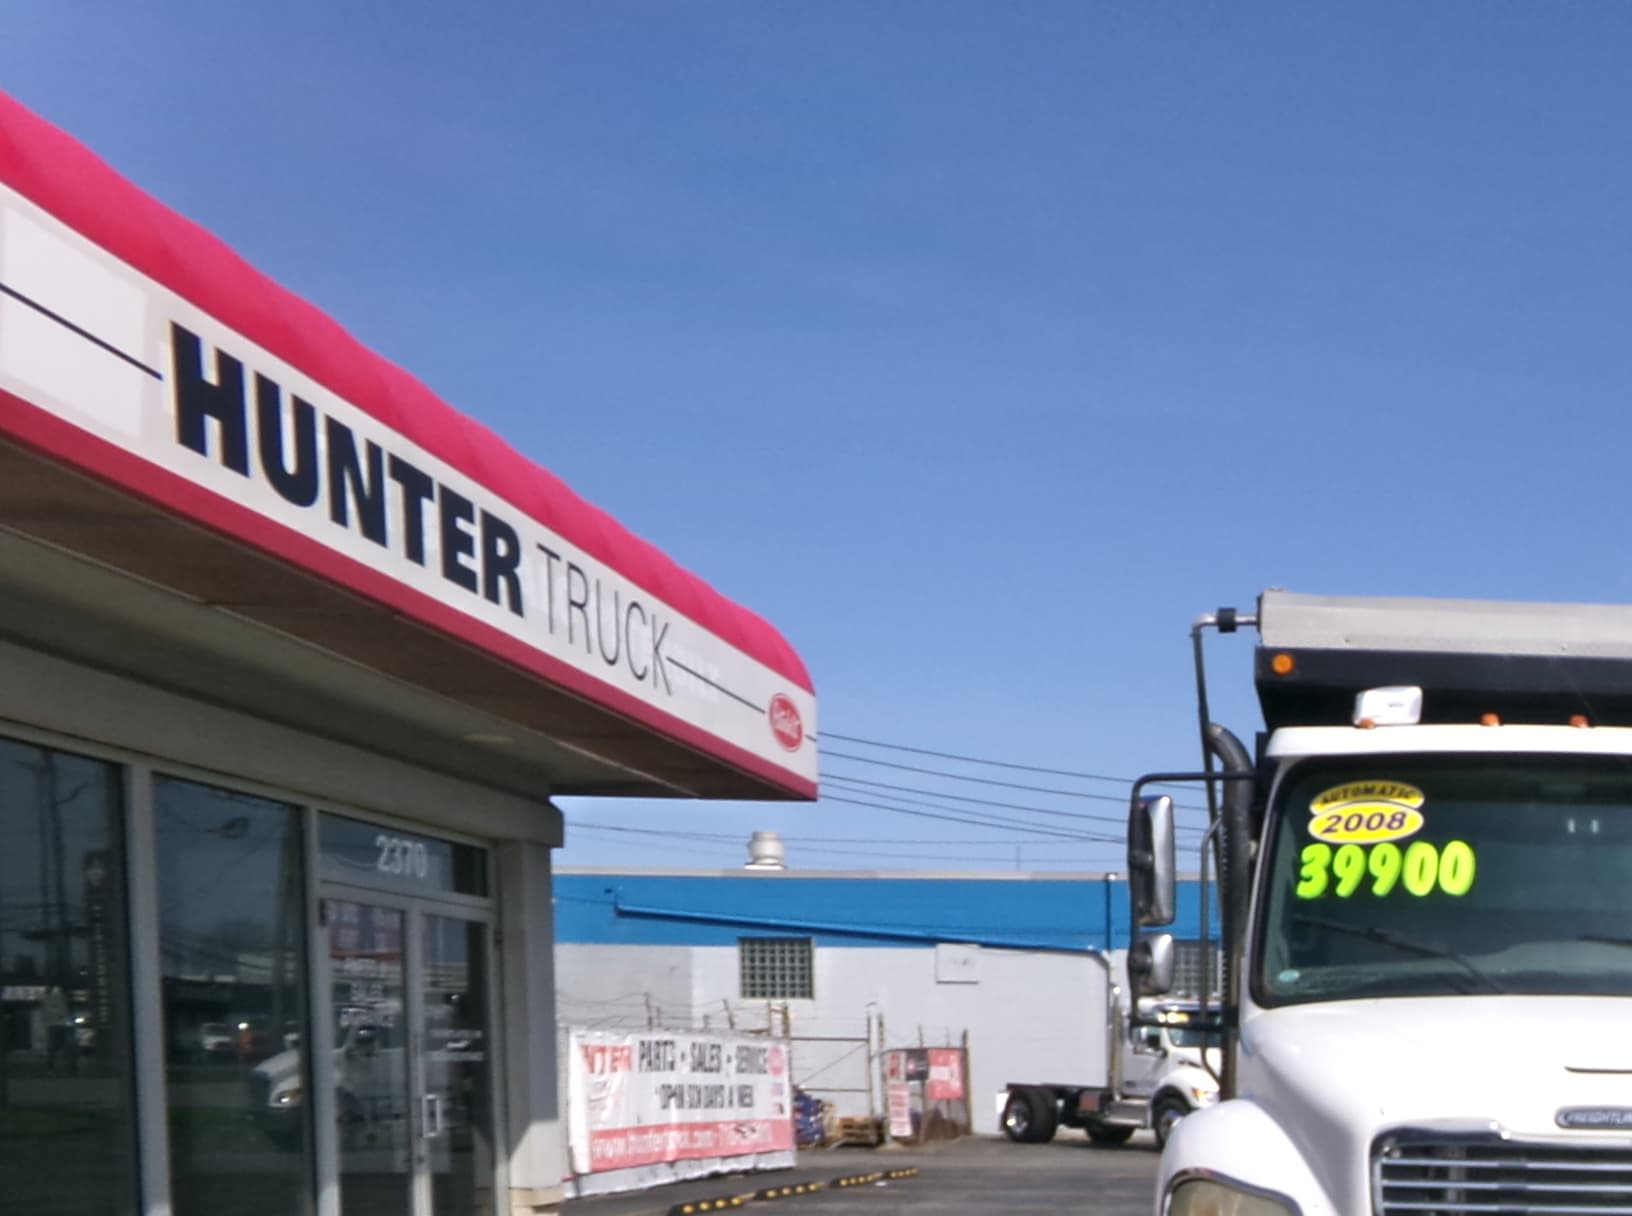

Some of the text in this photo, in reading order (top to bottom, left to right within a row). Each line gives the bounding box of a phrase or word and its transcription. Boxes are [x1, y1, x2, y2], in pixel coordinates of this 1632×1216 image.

[169, 321, 674, 698] HUNTER TRUCK
[1320, 782, 1415, 805] AUTOMATIC
[1320, 811, 1408, 834] 2008
[376, 835, 428, 878] 2370
[1296, 840, 1476, 899] 39900
[639, 1040, 675, 1073] PARTS
[691, 1042, 722, 1073] SALES
